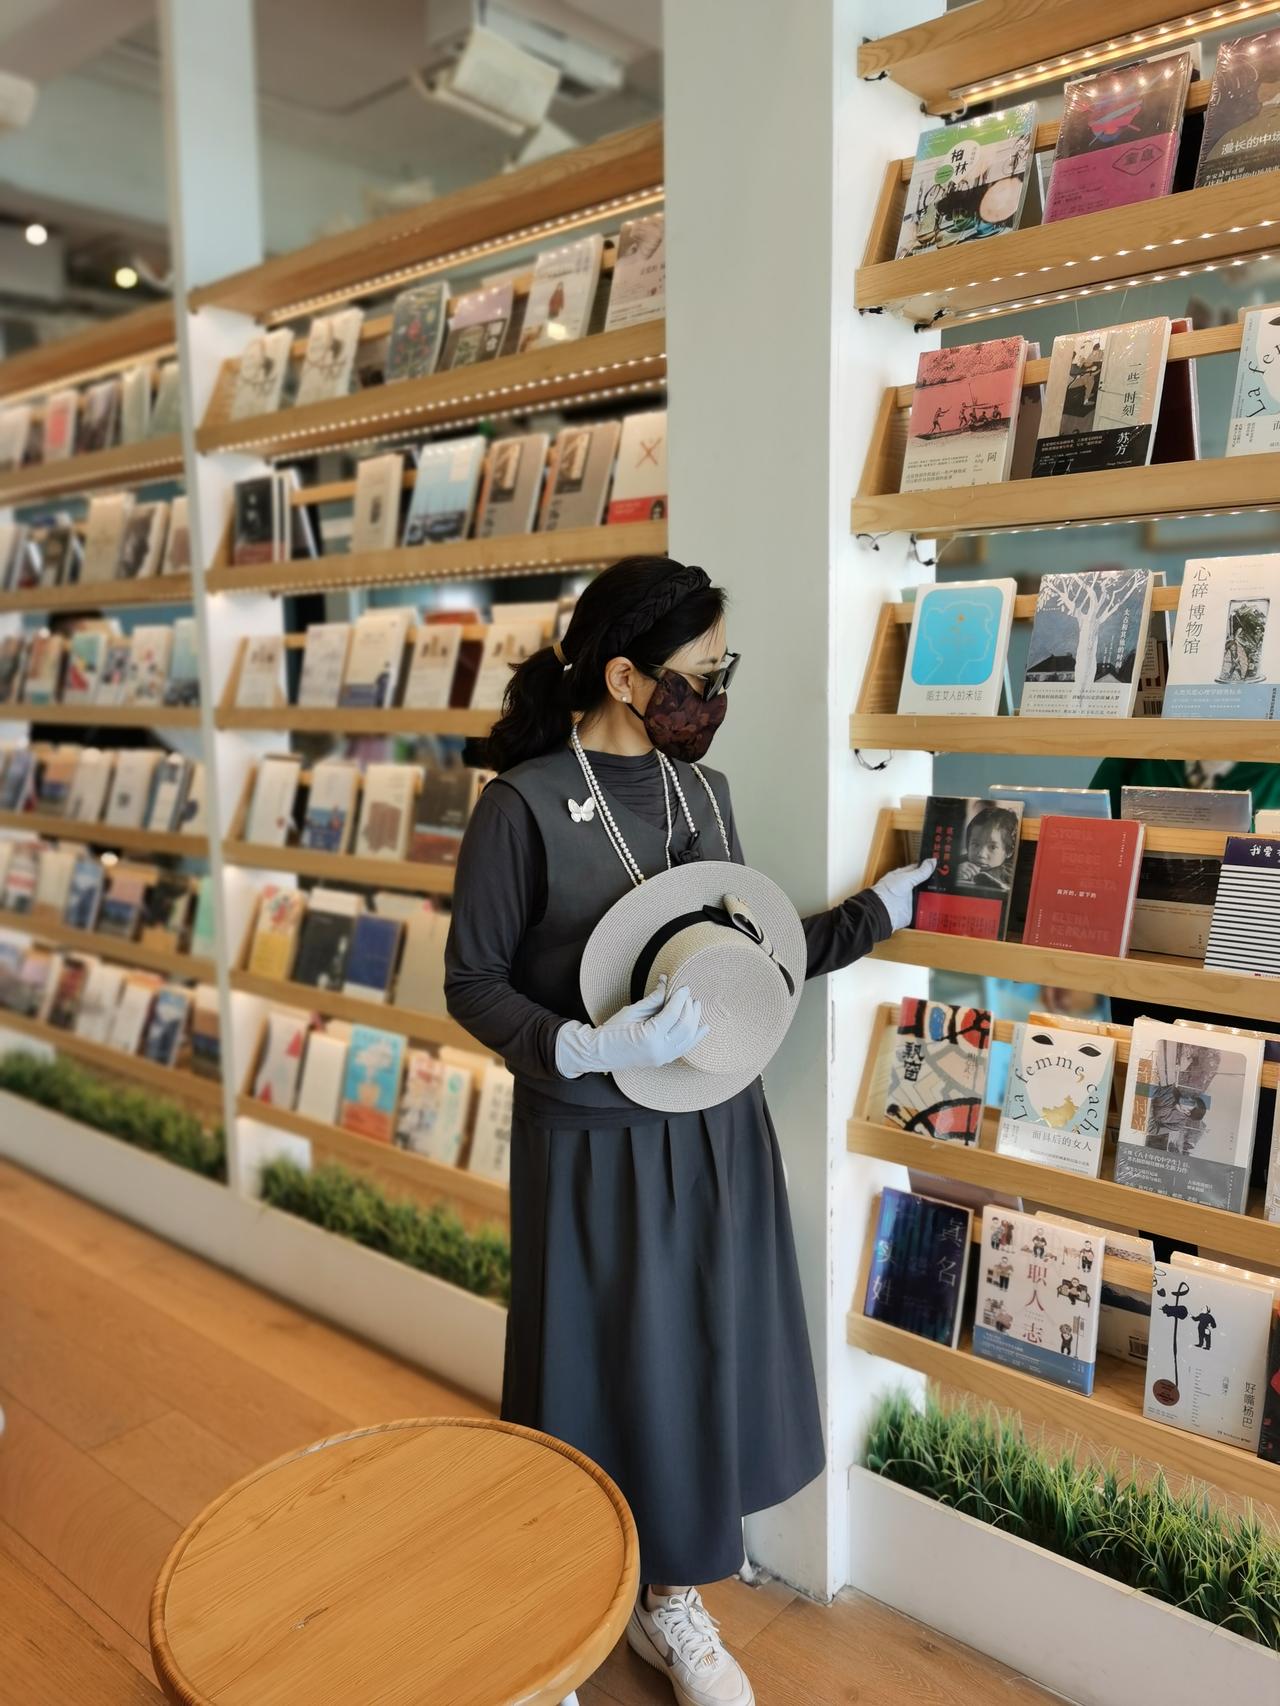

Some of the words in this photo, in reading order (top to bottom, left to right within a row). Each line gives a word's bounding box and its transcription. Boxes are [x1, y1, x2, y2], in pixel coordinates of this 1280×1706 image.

[951, 149, 968, 176] 柏林
[1122, 363, 1142, 417] 一些时刻
[1115, 431, 1131, 456] 苏方
[1183, 566, 1212, 655] 心碎博物馆
[1015, 1056, 1085, 1083] femme
[1022, 1264, 1048, 1343] 职人志
[1242, 1381, 1257, 1429] 好嘴杨巴
